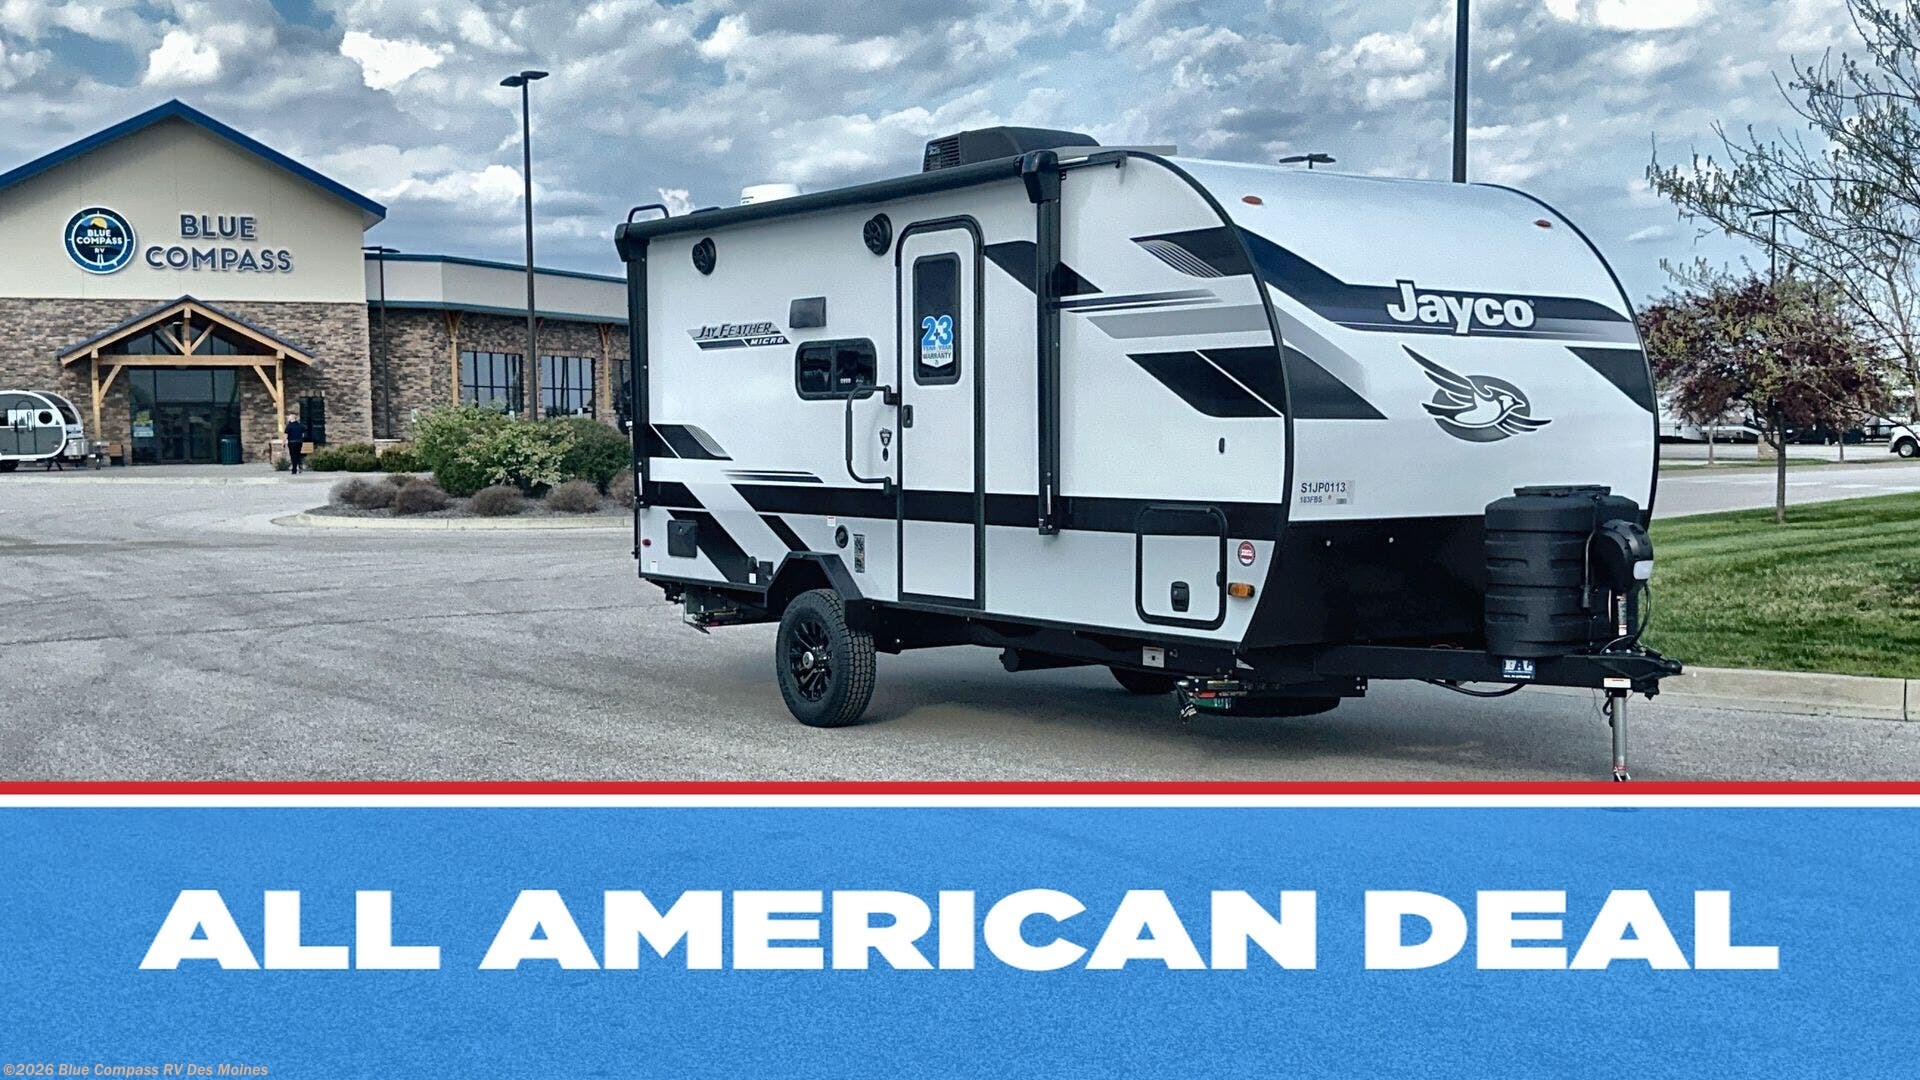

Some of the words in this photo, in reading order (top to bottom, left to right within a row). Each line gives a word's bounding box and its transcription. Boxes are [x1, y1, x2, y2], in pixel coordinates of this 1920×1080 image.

[180, 214, 256, 238] BLUE
[87, 229, 111, 237] BLUE
[76, 236, 123, 245] COMPASS
[145, 245, 293, 272] COMPASS
[1386, 280, 1535, 335] Jayco
[749, 336, 785, 345] MICRO
[923, 352, 952, 360] WARRANTY
[1300, 482, 1346, 493] S1JP0113
